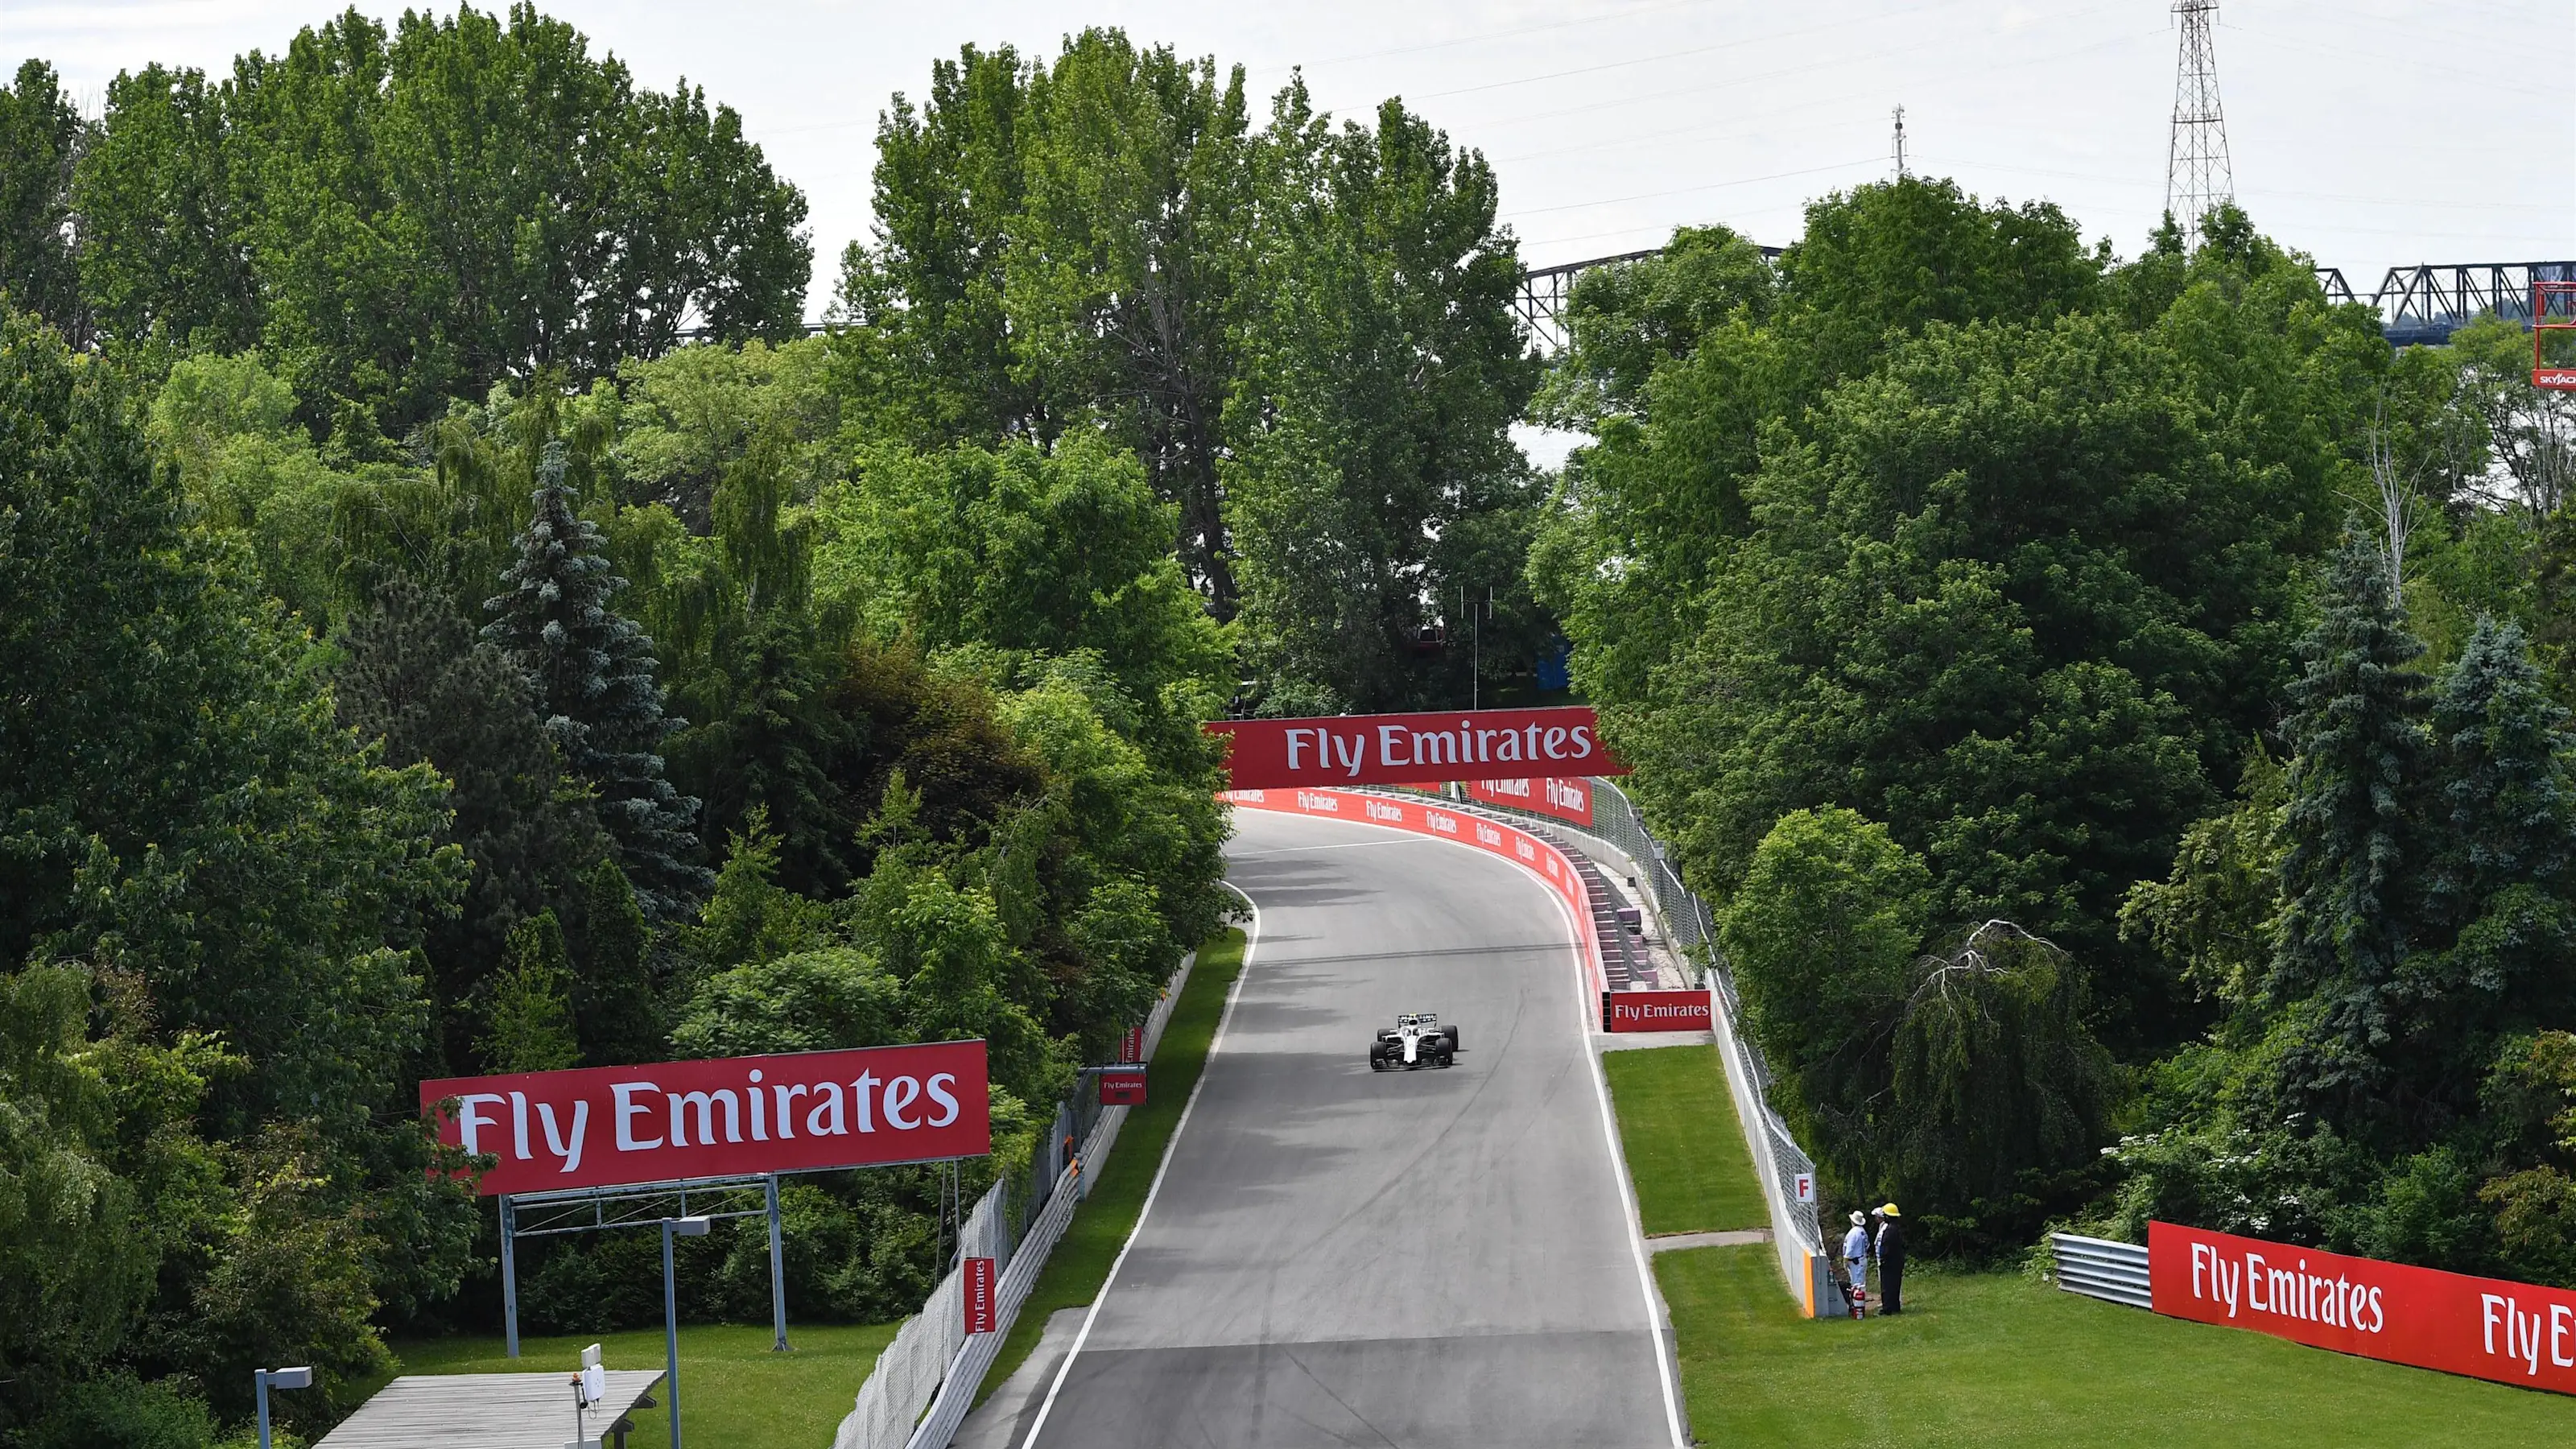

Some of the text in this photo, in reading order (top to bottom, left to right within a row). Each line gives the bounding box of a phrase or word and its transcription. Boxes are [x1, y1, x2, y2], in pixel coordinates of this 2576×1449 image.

[1285, 720, 1592, 777] Fly Emirates
[1298, 791, 1338, 812] Fly Emirates
[1365, 799, 1403, 822] Fly Emirates
[1546, 777, 1584, 812] Fly Emirates
[1615, 1003, 1710, 1022] Fly Emirates
[455, 1067, 960, 1173] Fly Emirates
[1799, 1179, 1809, 1198] F
[974, 1260, 987, 1332] Fly Emirates
[2190, 1242, 2384, 1334] Fly Emirates
[2481, 1293, 2576, 1376] Fly E
